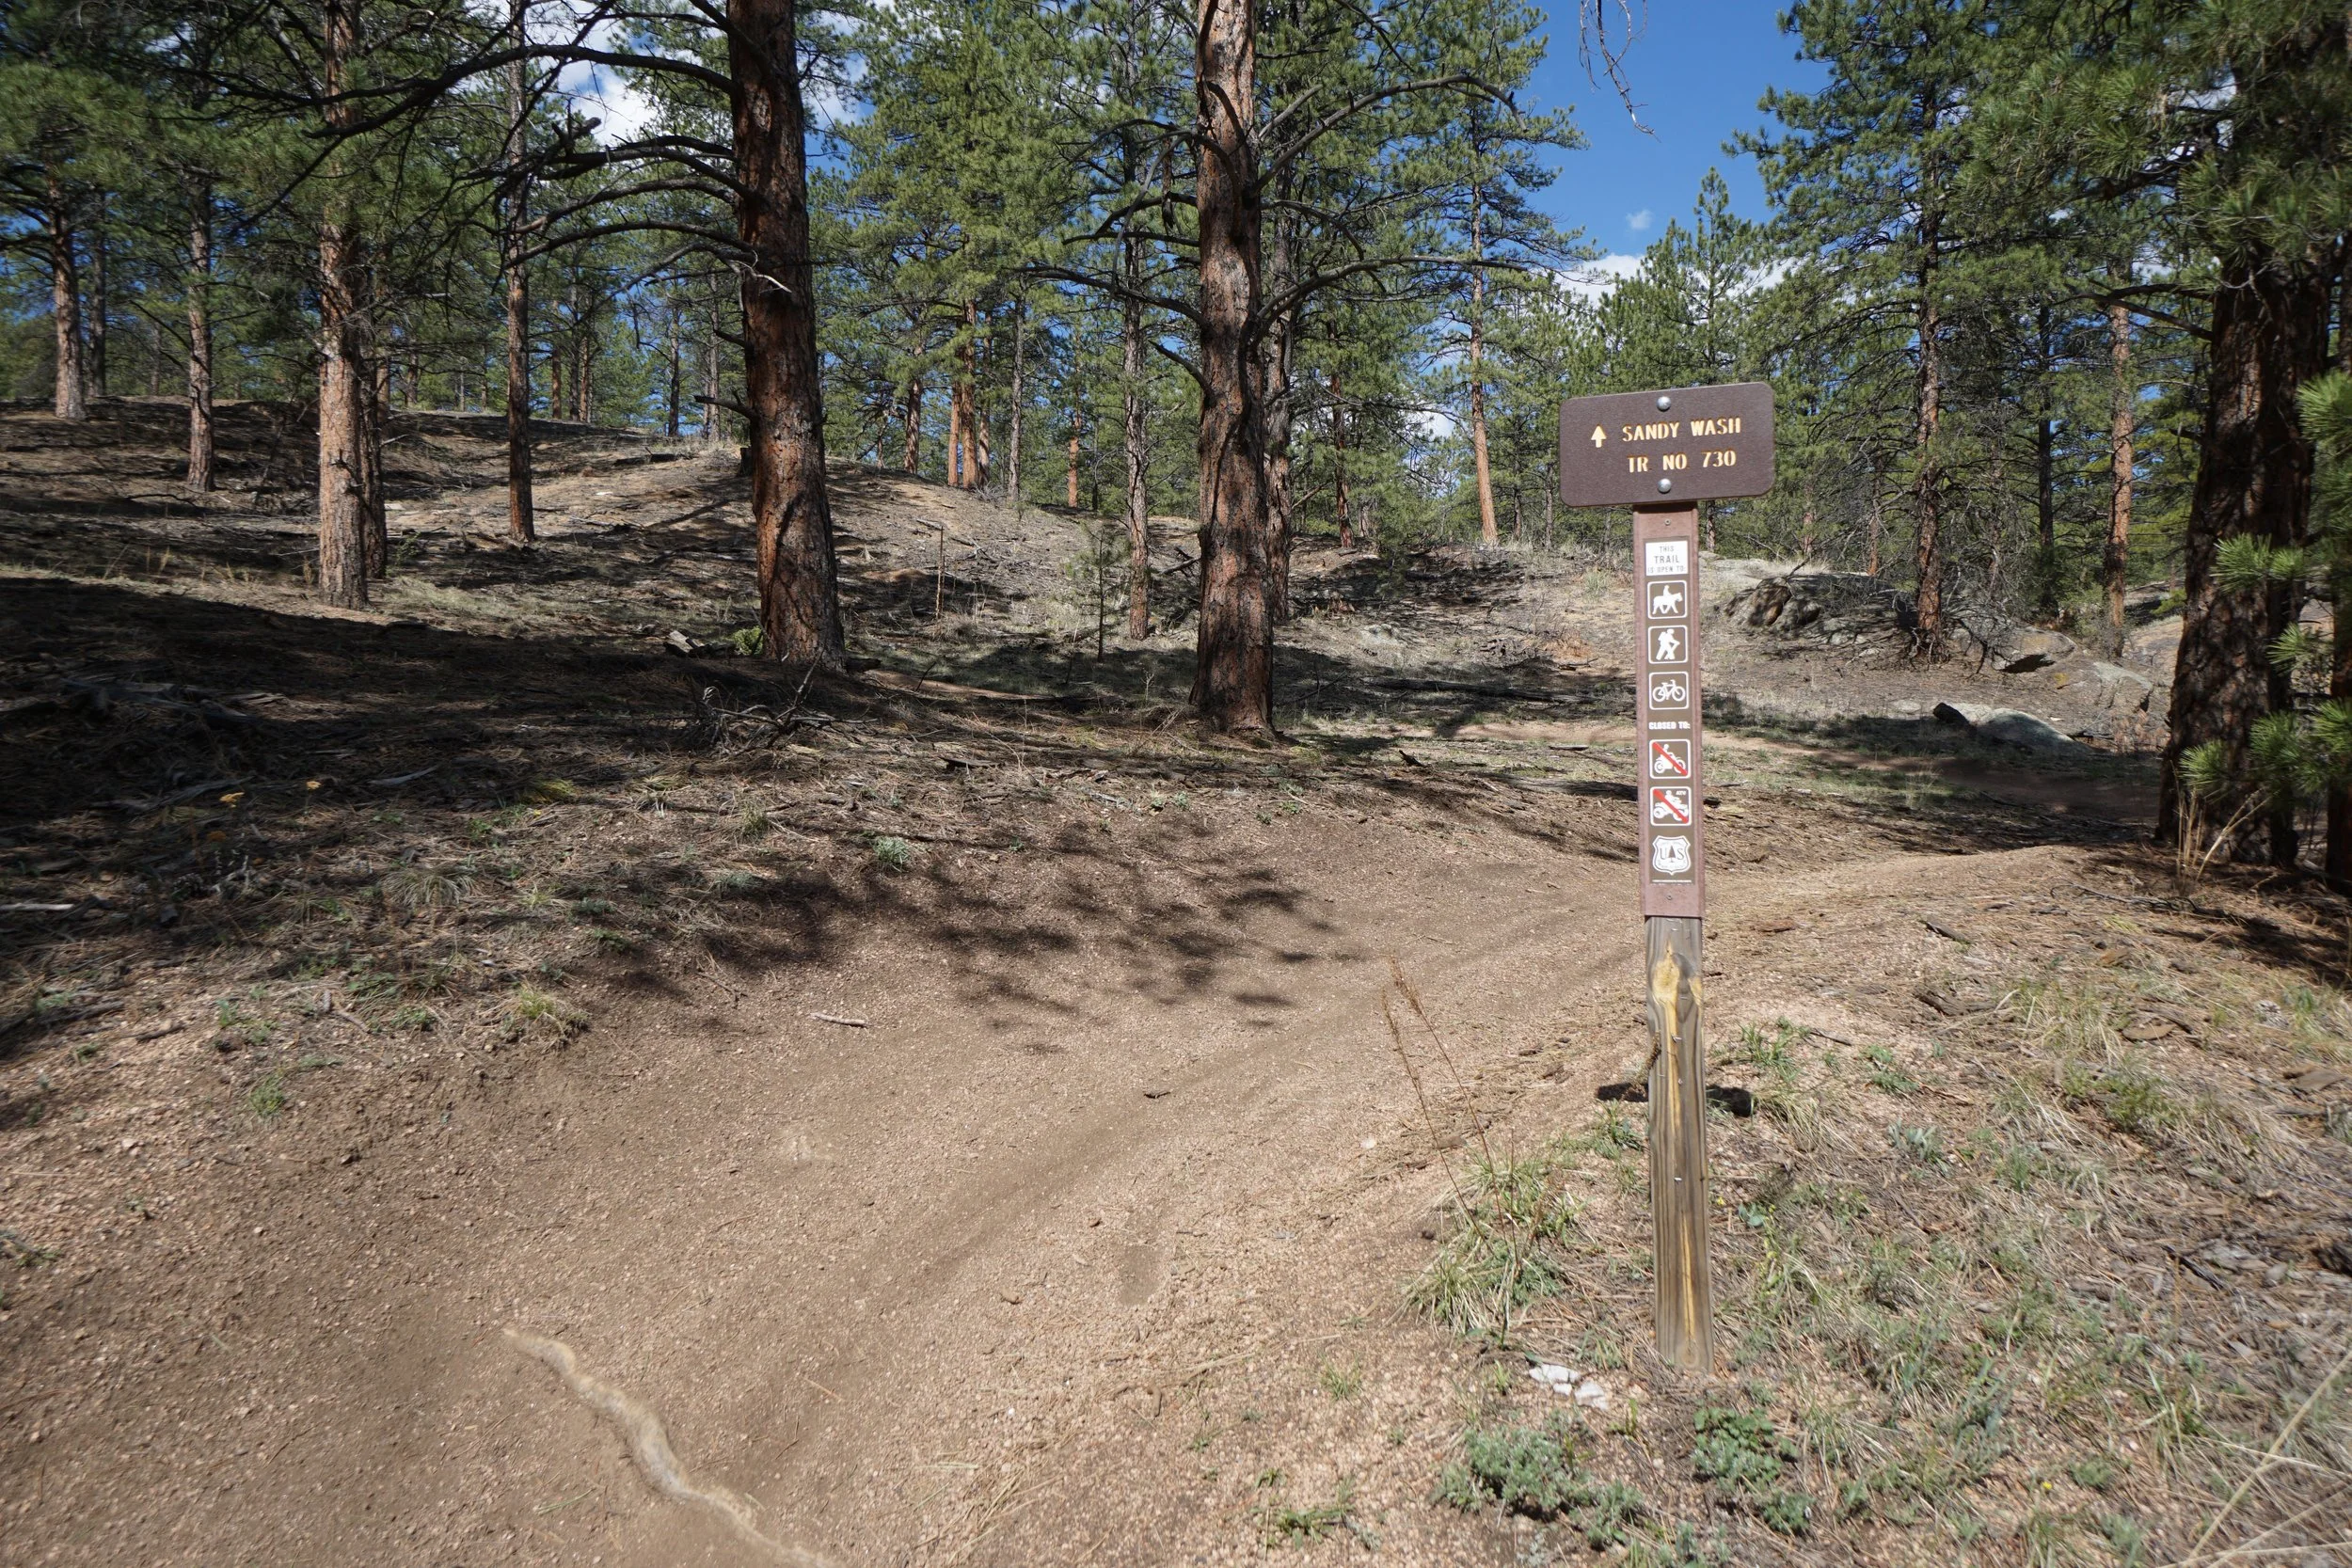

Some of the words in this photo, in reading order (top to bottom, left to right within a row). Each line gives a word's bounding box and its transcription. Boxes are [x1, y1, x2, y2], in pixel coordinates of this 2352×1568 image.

[1622, 422, 1680, 442] SANDY
[1691, 417, 1741, 436] WASH
[1701, 449, 1737, 468] 730
[1654, 555, 1679, 563] TRAIL
[1648, 721, 1677, 730] CLOSED
